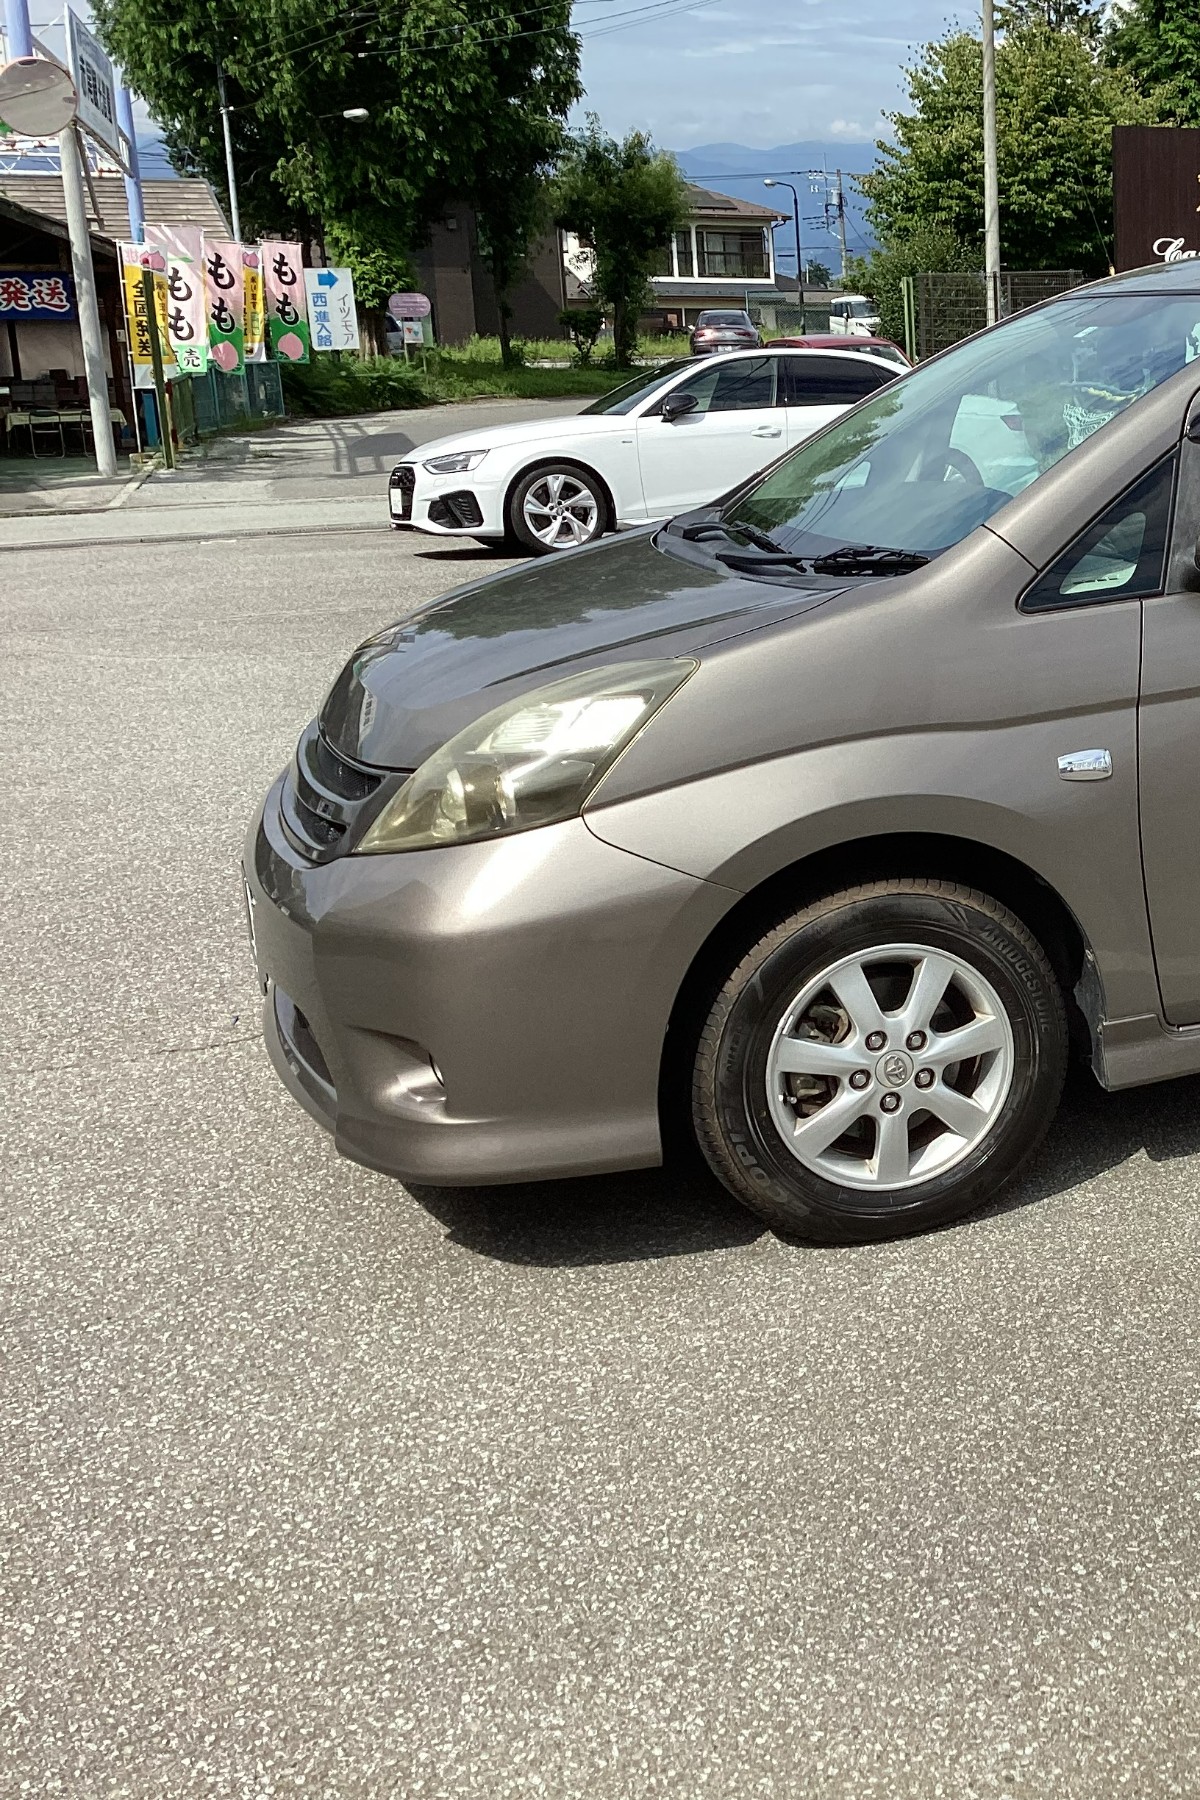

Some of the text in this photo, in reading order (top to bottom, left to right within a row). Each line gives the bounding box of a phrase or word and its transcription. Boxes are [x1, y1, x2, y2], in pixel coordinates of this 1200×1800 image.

[168, 267, 194, 341] もも
[207, 252, 236, 334] もも
[273, 252, 300, 326] もも
[311, 292, 333, 348] 西進入路
[337, 293, 354, 346] イツモア
